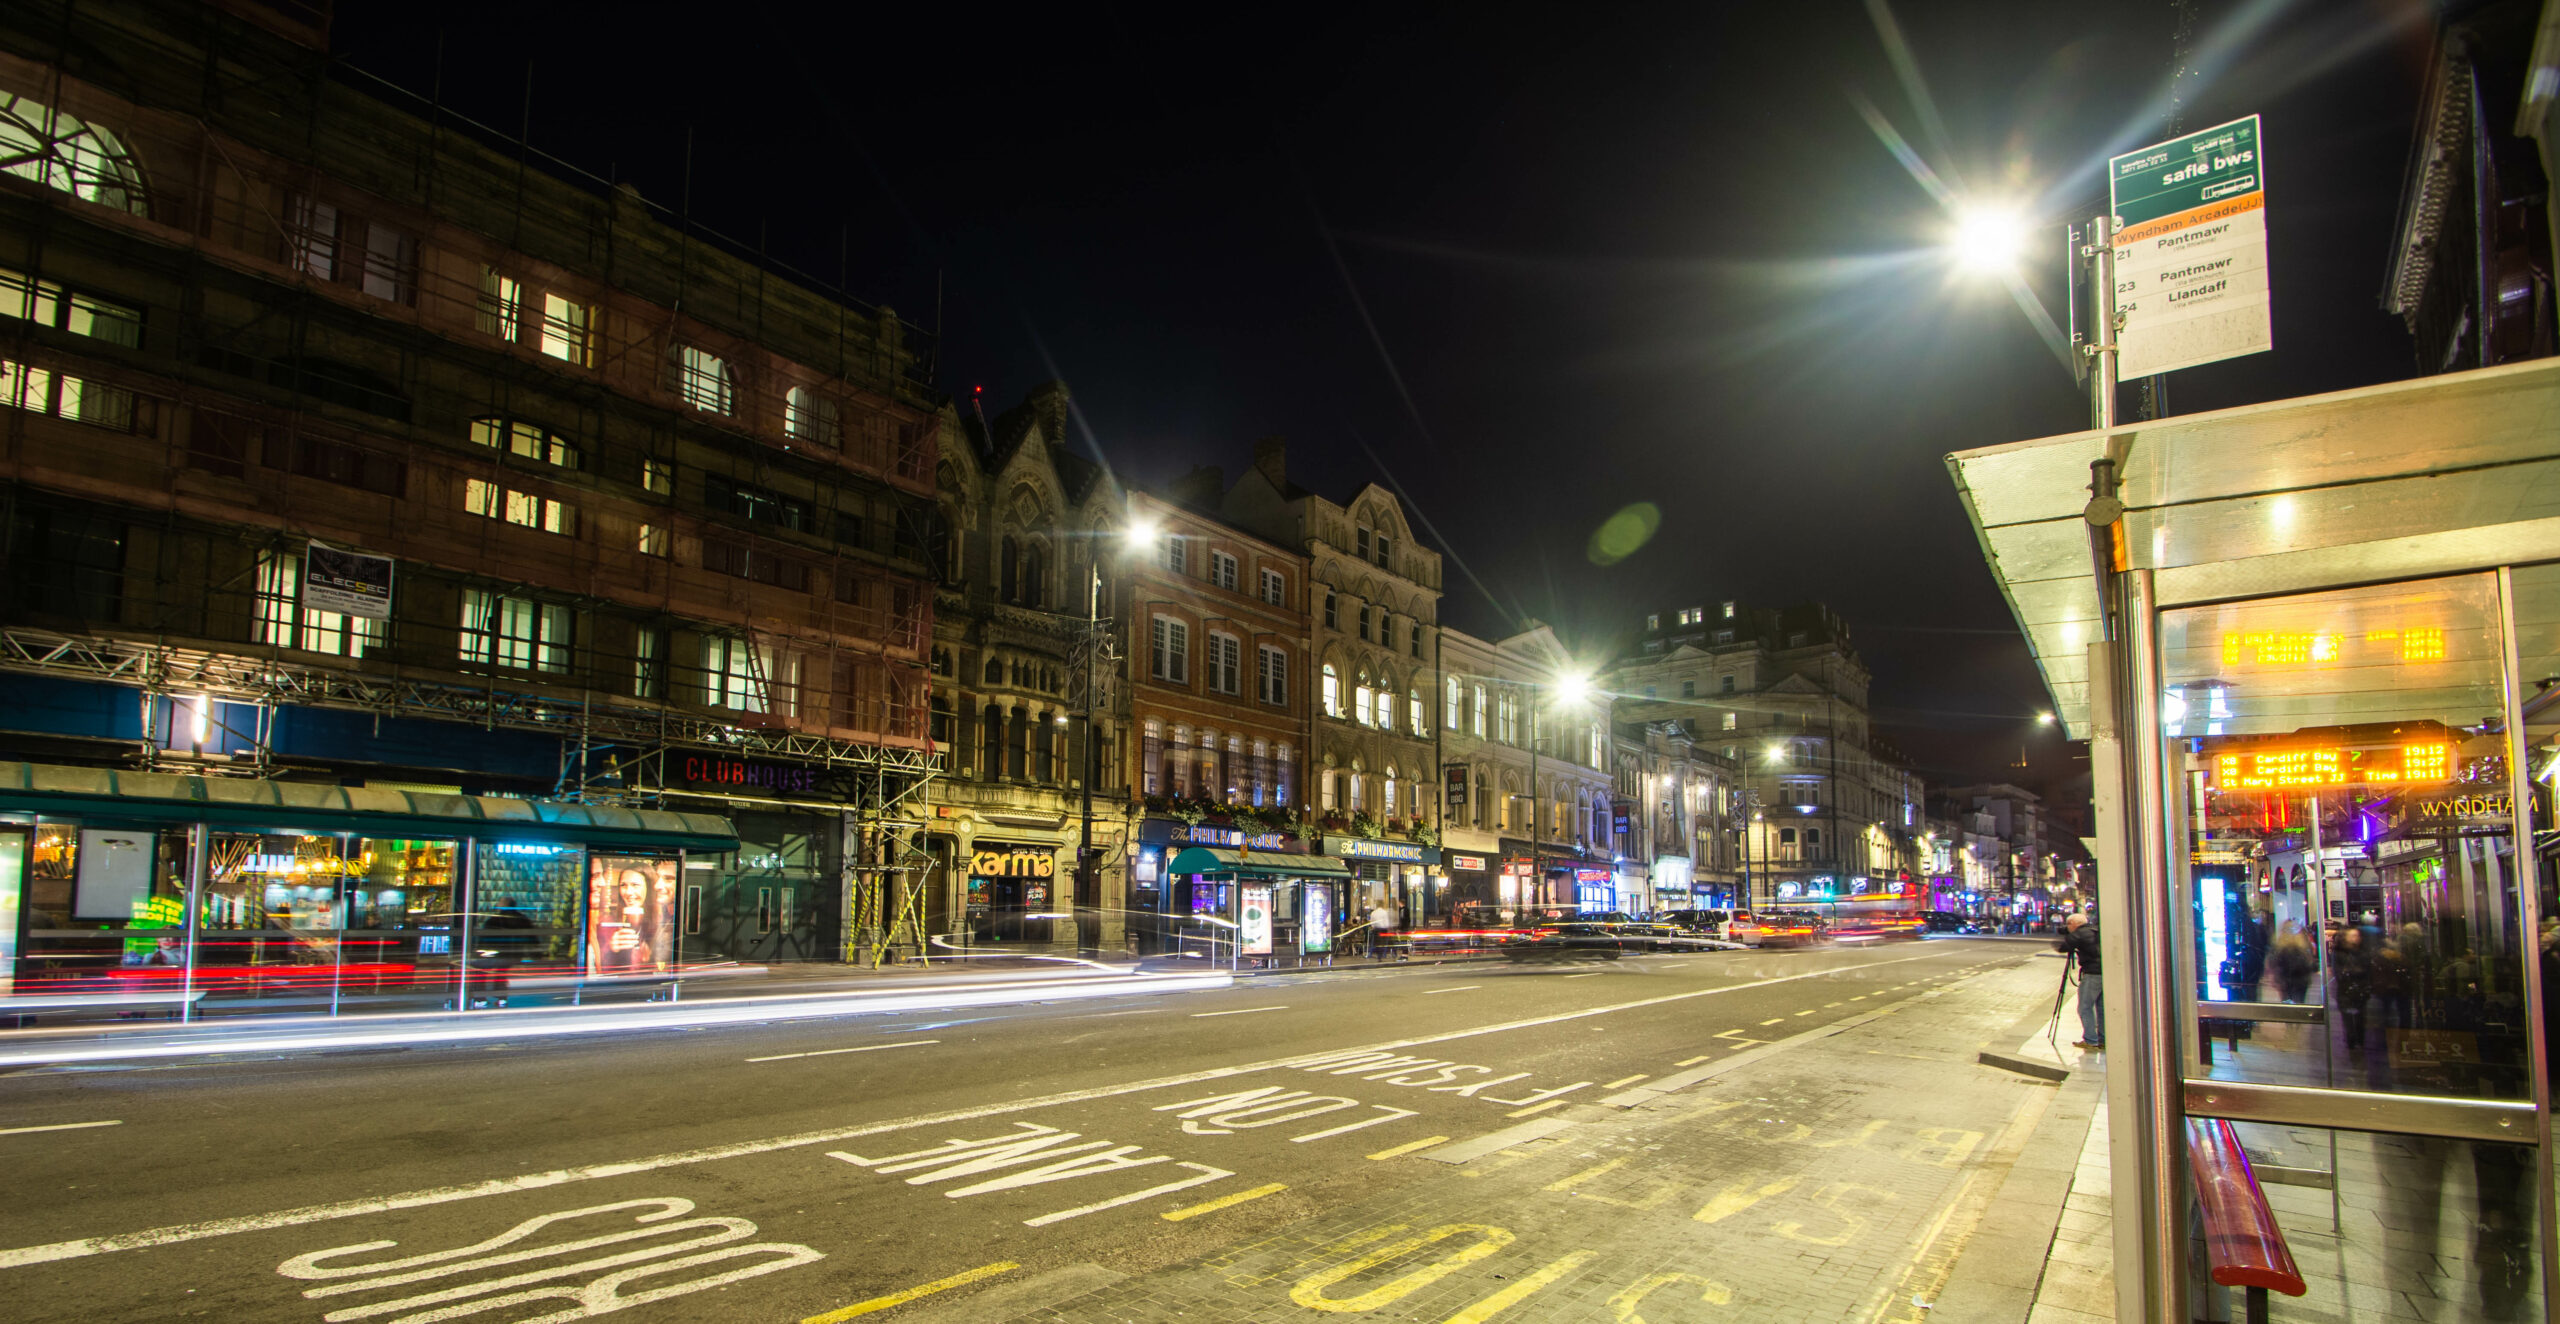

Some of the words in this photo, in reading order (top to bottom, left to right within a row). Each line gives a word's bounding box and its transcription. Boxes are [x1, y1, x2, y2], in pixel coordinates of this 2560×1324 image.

[2163, 162, 2209, 186] safle
[2213, 150, 2253, 171] bws
[2116, 221, 2182, 243] Wyndham
[2116, 249, 2131, 261] 21
[2158, 223, 2230, 249] Pantmawr
[2118, 281, 2136, 293] 23
[2160, 257, 2233, 282] Pantmawr
[2119, 302, 2137, 313] 24
[2168, 280, 2227, 302] Llandaff
[311, 573, 388, 594] ELECSEC
[2256, 753, 2307, 763] Cardiff
[2313, 752, 2337, 762] Bay
[2405, 745, 2444, 756] 19:12
[686, 757, 816, 792] CLUBHOUSE
[2257, 764, 2307, 774] Cardiff
[2314, 763, 2337, 773] Bay
[2405, 757, 2444, 767] 19:27
[1450, 783, 1463, 792] BAR
[2222, 778, 2237, 787] St
[2243, 777, 2272, 787] Mary
[2279, 775, 2322, 784] Street
[2367, 772, 2397, 780] Time
[2406, 769, 2443, 779] 19:11
[1615, 816, 1627, 824] BAR
[1170, 825, 1190, 841] The
[1341, 841, 1355, 854] The
[1355, 841, 1422, 860] PHILHARMONIC
[967, 848, 1053, 877] karma
[825, 1121, 1236, 1227] LANE
[276, 1197, 827, 1324] BUS
